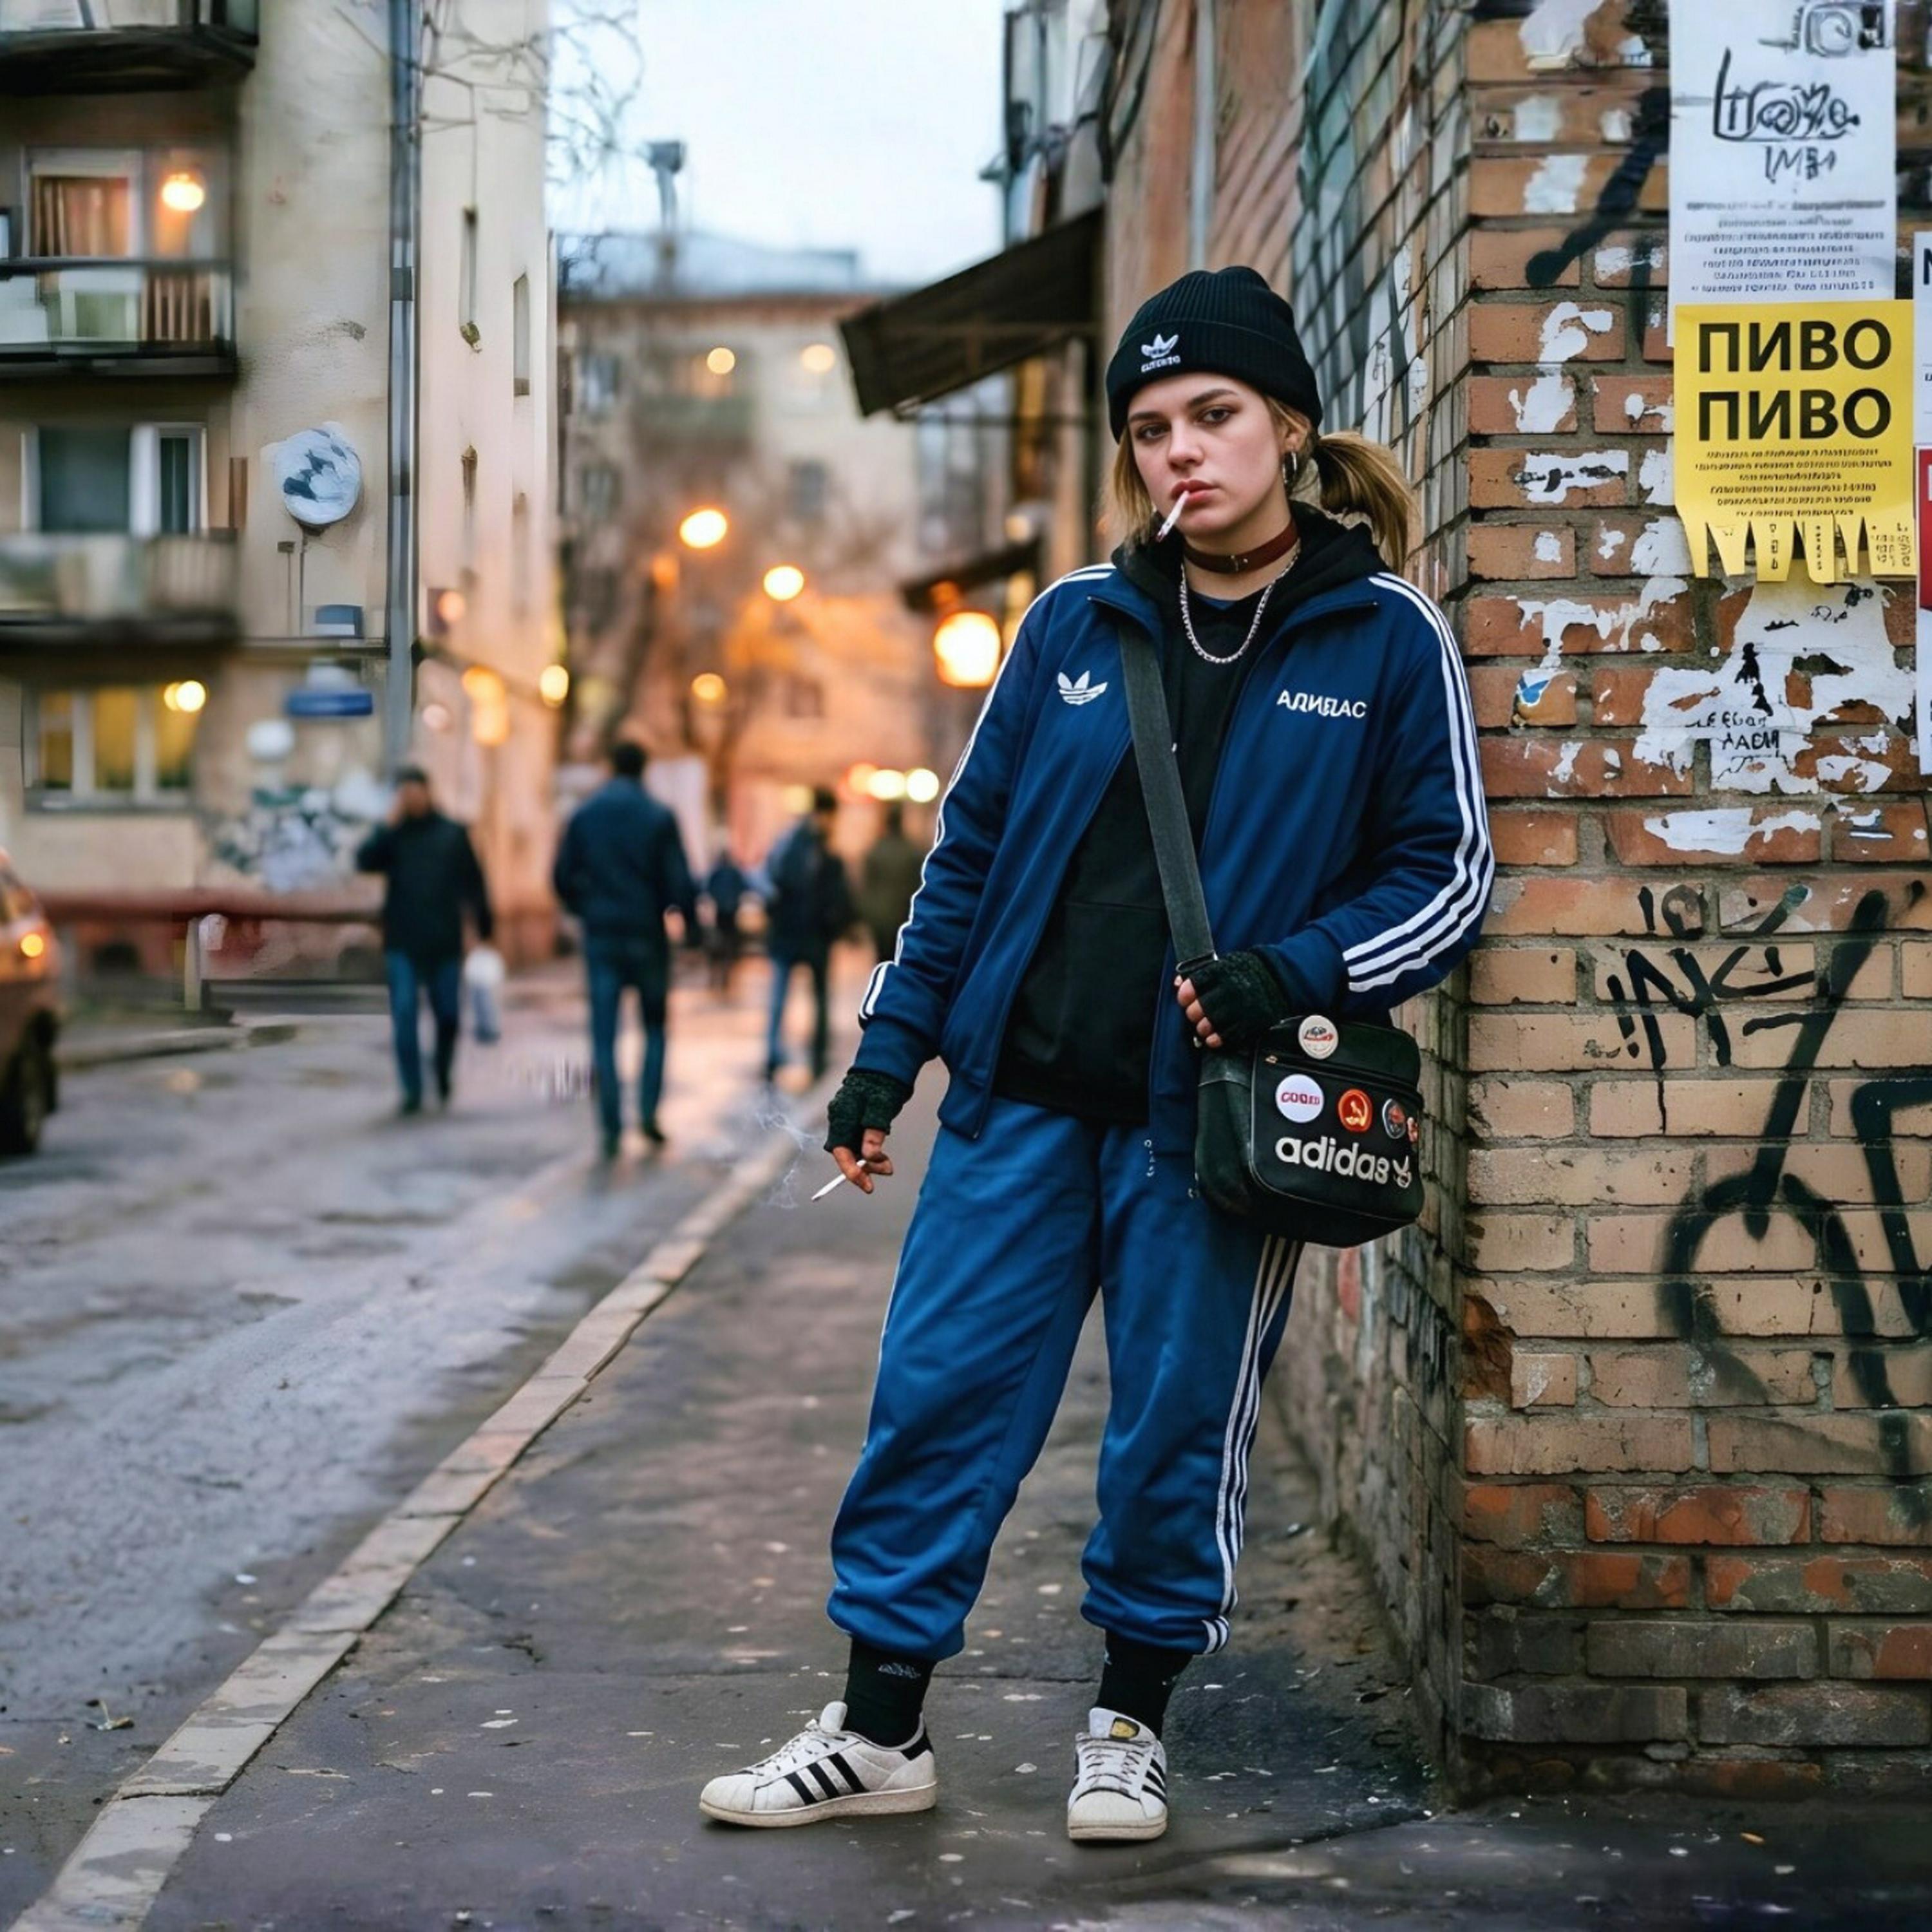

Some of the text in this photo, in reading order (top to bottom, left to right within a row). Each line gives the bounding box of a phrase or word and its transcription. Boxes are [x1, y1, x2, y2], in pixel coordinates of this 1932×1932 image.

[1699, 319, 1891, 373] ПИВО
[1699, 388, 1891, 441] ПИВО
[1274, 1135, 1390, 1185] adidas
